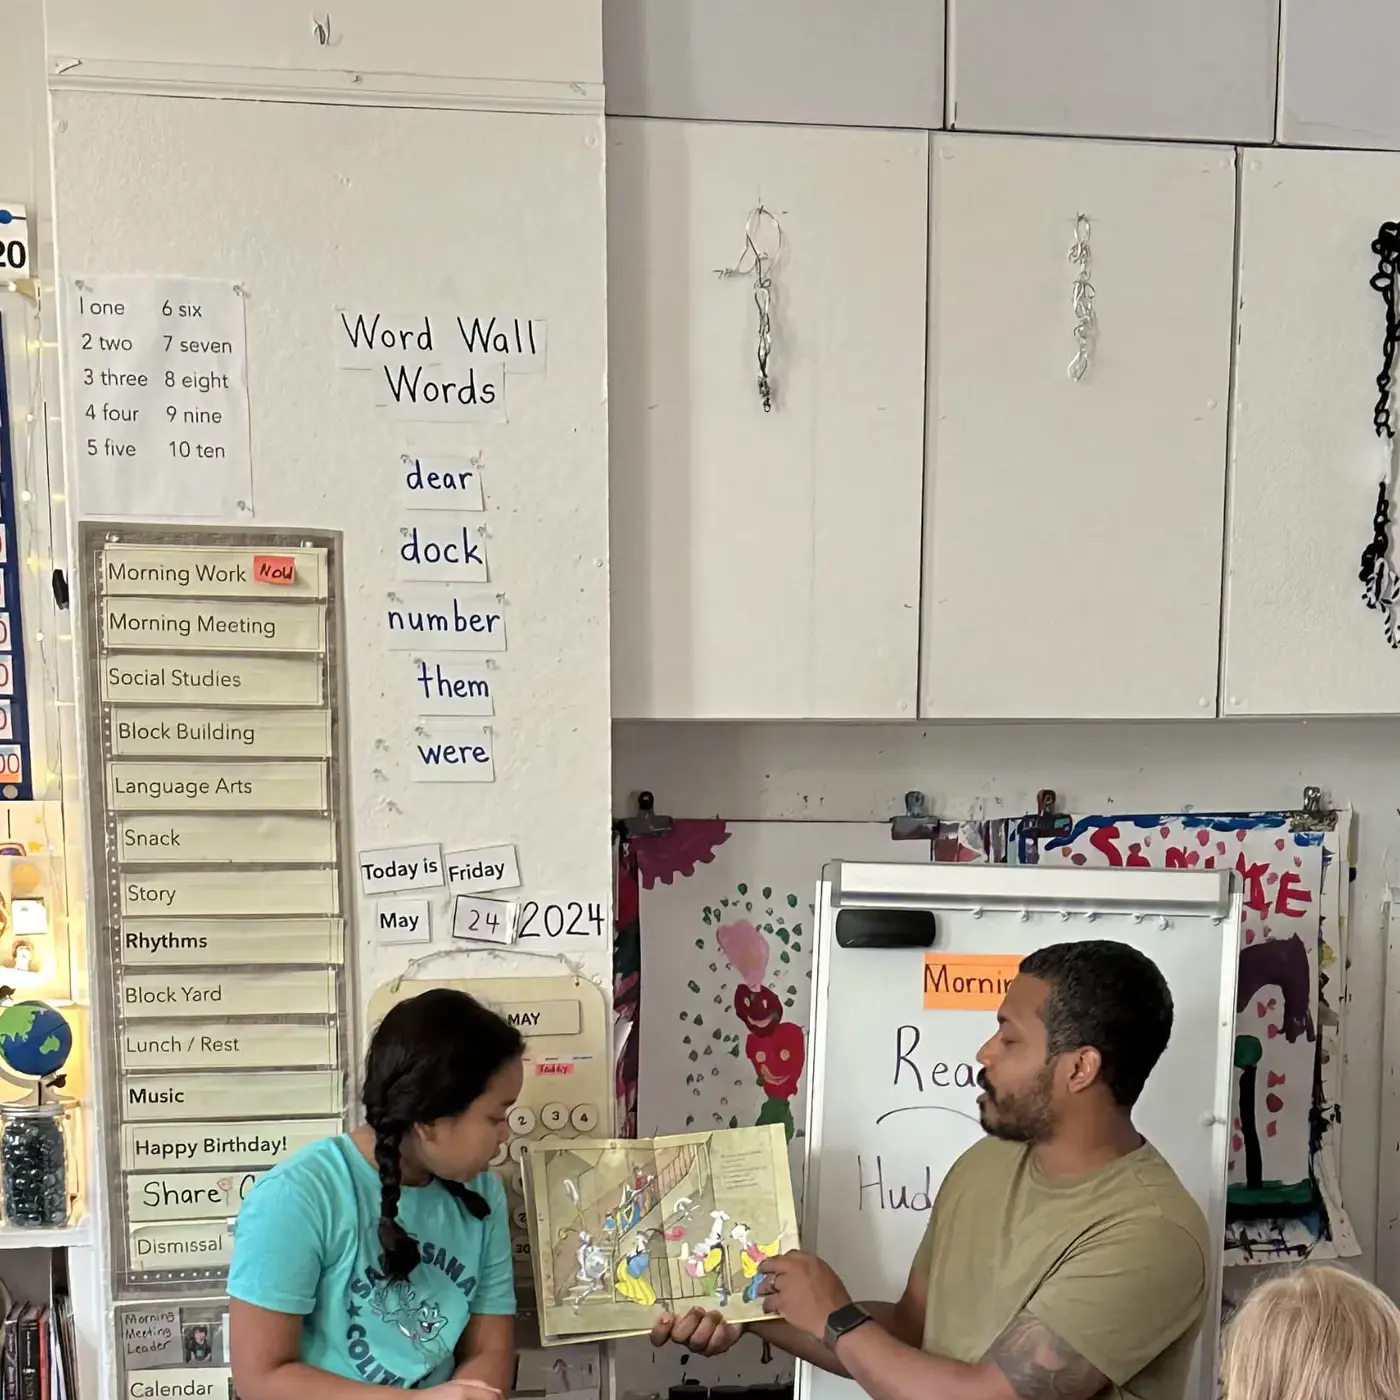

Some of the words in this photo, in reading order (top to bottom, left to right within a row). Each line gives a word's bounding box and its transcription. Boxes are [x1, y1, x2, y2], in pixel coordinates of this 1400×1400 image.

[0, 240, 26, 269] 0
[90, 301, 125, 316] one
[162, 299, 173, 317] 6
[179, 303, 203, 318] six
[81, 333, 93, 350] 2
[99, 337, 133, 351] two
[163, 335, 174, 352] 7
[180, 340, 233, 354] seven
[341, 313, 433, 352] Word
[457, 316, 536, 355] Wall
[84, 368, 94, 386] 3
[101, 368, 148, 386] three
[164, 371, 175, 388] 8
[181, 371, 229, 393] eight
[384, 365, 496, 405] Words
[85, 404, 96, 421] 4
[103, 403, 140, 422] four
[166, 406, 177, 423] 9
[183, 406, 222, 424] nine
[87, 439, 98, 456] 5
[104, 438, 137, 457] five
[169, 441, 191, 458] 10
[196, 444, 226, 459] ten
[406, 459, 473, 490] dear
[400, 526, 483, 565] dock
[108, 563, 191, 587] Morning
[195, 563, 247, 583] Work
[109, 613, 191, 637] Morning
[197, 615, 276, 639] Meeting
[387, 598, 501, 633] number
[109, 668, 166, 687] Social
[171, 669, 242, 688] Studies
[417, 661, 490, 699] them
[118, 722, 171, 741] Block
[176, 722, 256, 745] Building
[417, 744, 490, 766] were
[115, 777, 210, 799] Language
[214, 777, 253, 795] Arts
[124, 828, 181, 848] Snack
[361, 860, 418, 882] Today
[423, 857, 438, 875] is
[449, 860, 506, 883] Friday
[127, 884, 177, 906] Story
[379, 912, 420, 932] May
[467, 908, 501, 936] 24
[518, 900, 606, 938] 2024
[125, 932, 208, 954] Rhythms
[125, 985, 178, 1005] Block
[180, 984, 223, 1003] Yard
[507, 1012, 541, 1027] MAY
[126, 1036, 182, 1054] Lunch
[187, 1037, 195, 1053] /
[200, 1035, 240, 1053] Rest
[893, 1024, 977, 1092] Rea
[129, 1087, 185, 1105] Music
[551, 1110, 560, 1121] 3
[135, 1139, 199, 1159] Happy
[203, 1135, 288, 1156] Birthday!
[143, 1180, 222, 1208] Share
[857, 1154, 932, 1212] Hud
[137, 1234, 223, 1256] Dismissal
[421, 1241, 477, 1298] SANA
[125, 1311, 175, 1325] Morning
[127, 1340, 172, 1355] Leader
[130, 1379, 214, 1399] Calendar
